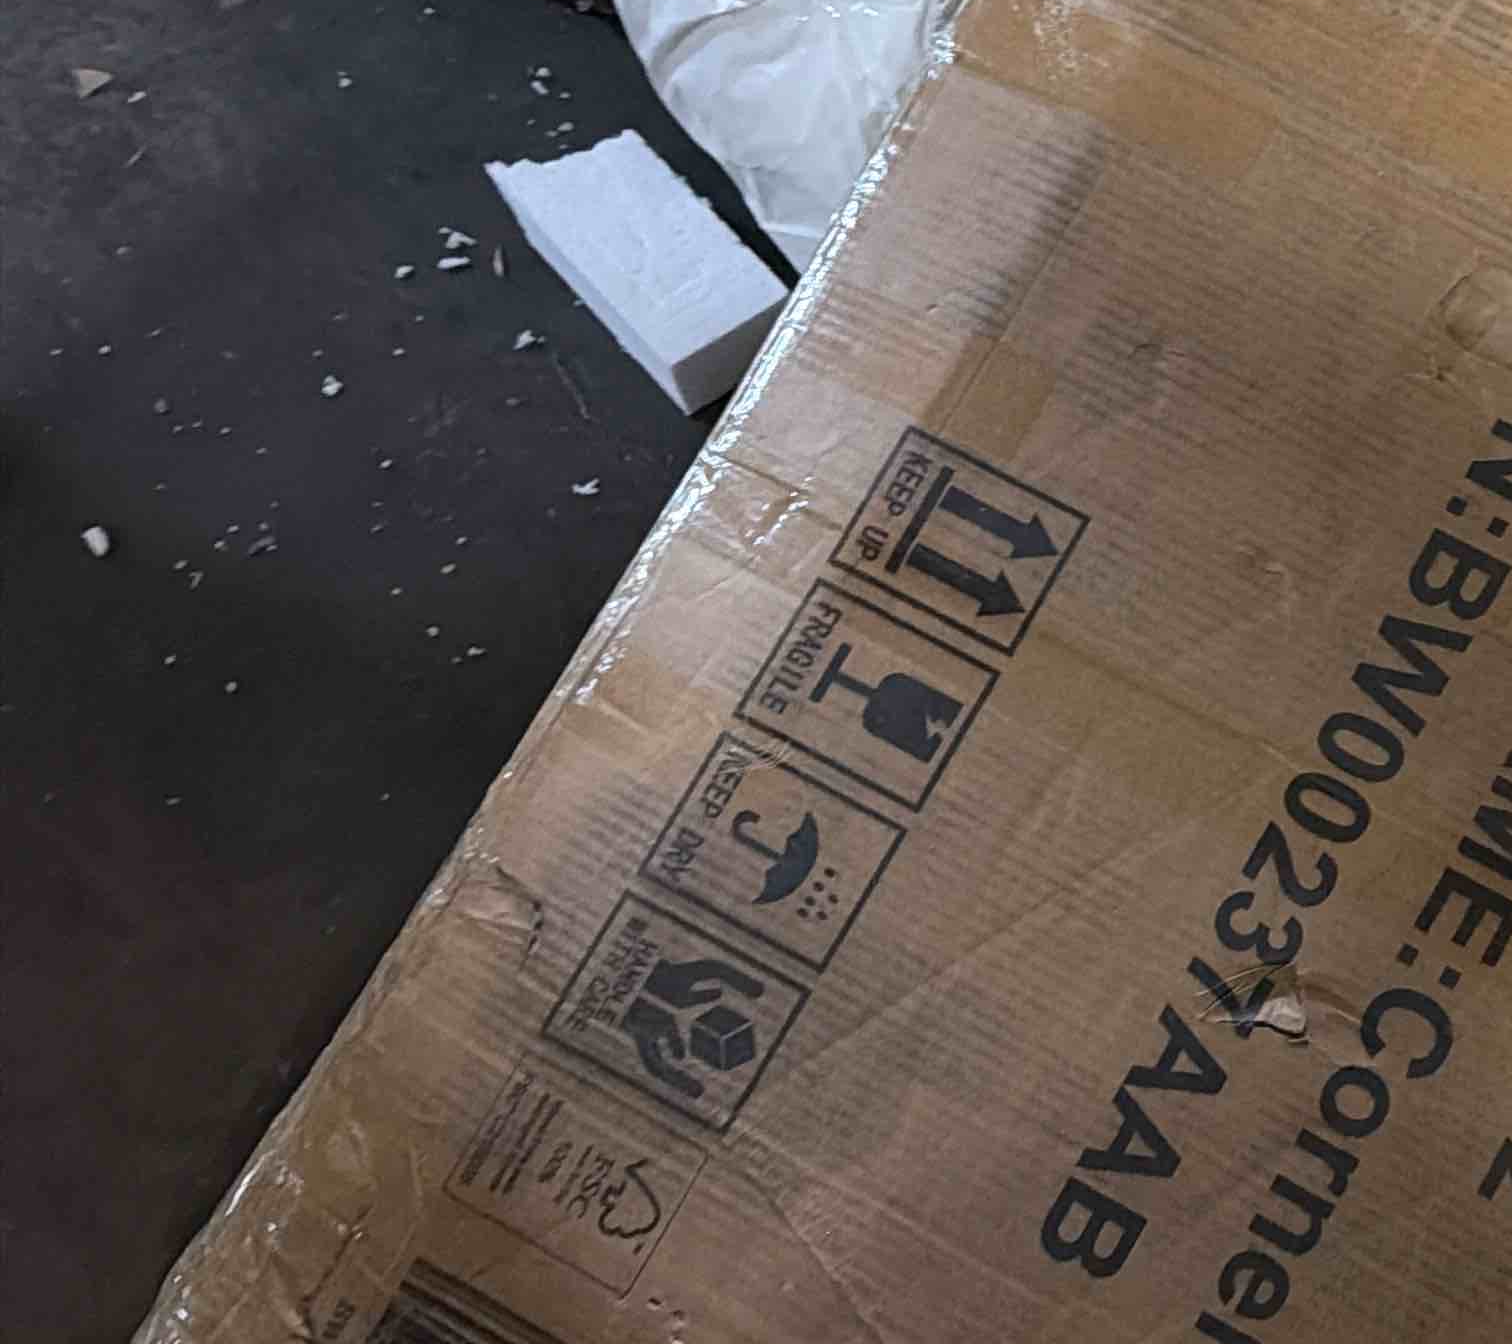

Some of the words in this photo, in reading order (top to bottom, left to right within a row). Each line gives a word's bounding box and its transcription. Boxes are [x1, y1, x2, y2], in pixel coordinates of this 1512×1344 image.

[883, 451, 932, 517] KEEP
[856, 525, 889, 562] UP
[759, 601, 843, 714] FRAGILE
[660, 826, 705, 884] DRY
[564, 975, 609, 1033] CARE
[565, 1153, 615, 1218] FSC
